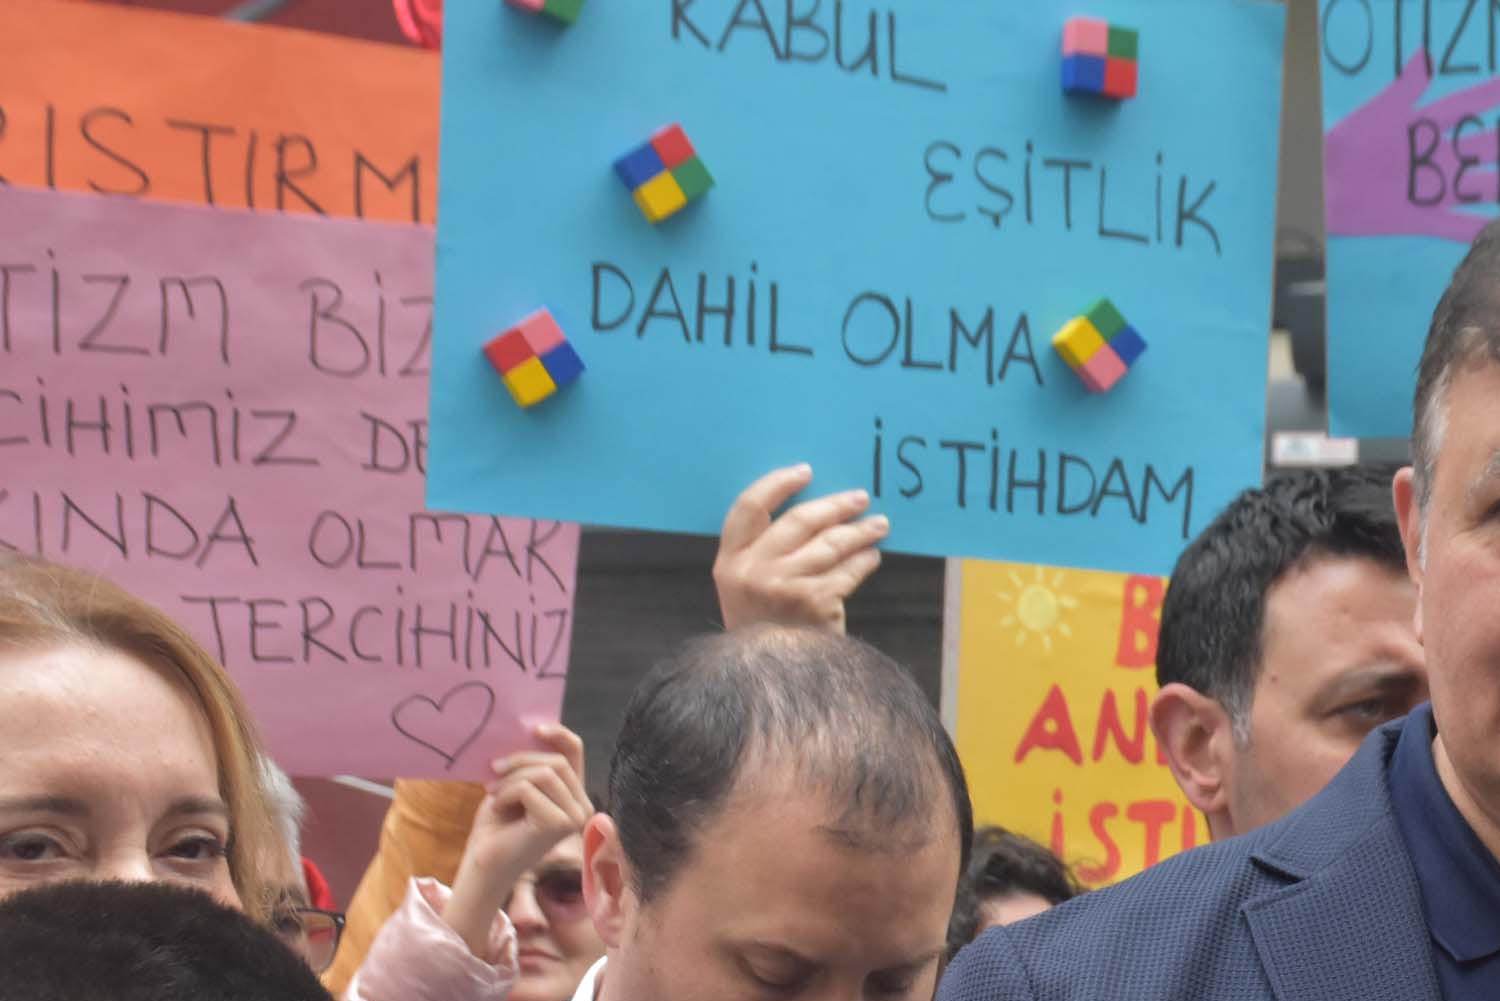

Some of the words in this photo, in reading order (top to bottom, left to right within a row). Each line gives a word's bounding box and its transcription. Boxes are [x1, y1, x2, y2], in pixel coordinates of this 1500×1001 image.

[671, 0, 947, 92] KABUL
[924, 139, 1222, 255] EŞİTLİK
[590, 261, 814, 356] DAHİL
[840, 291, 1046, 389] OLMA
[869, 417, 1196, 541] İSTİHDAM
[0, 489, 258, 568] INDA
[309, 509, 567, 593] OLMAK
[180, 585, 568, 680] TERCİHİNİZ
